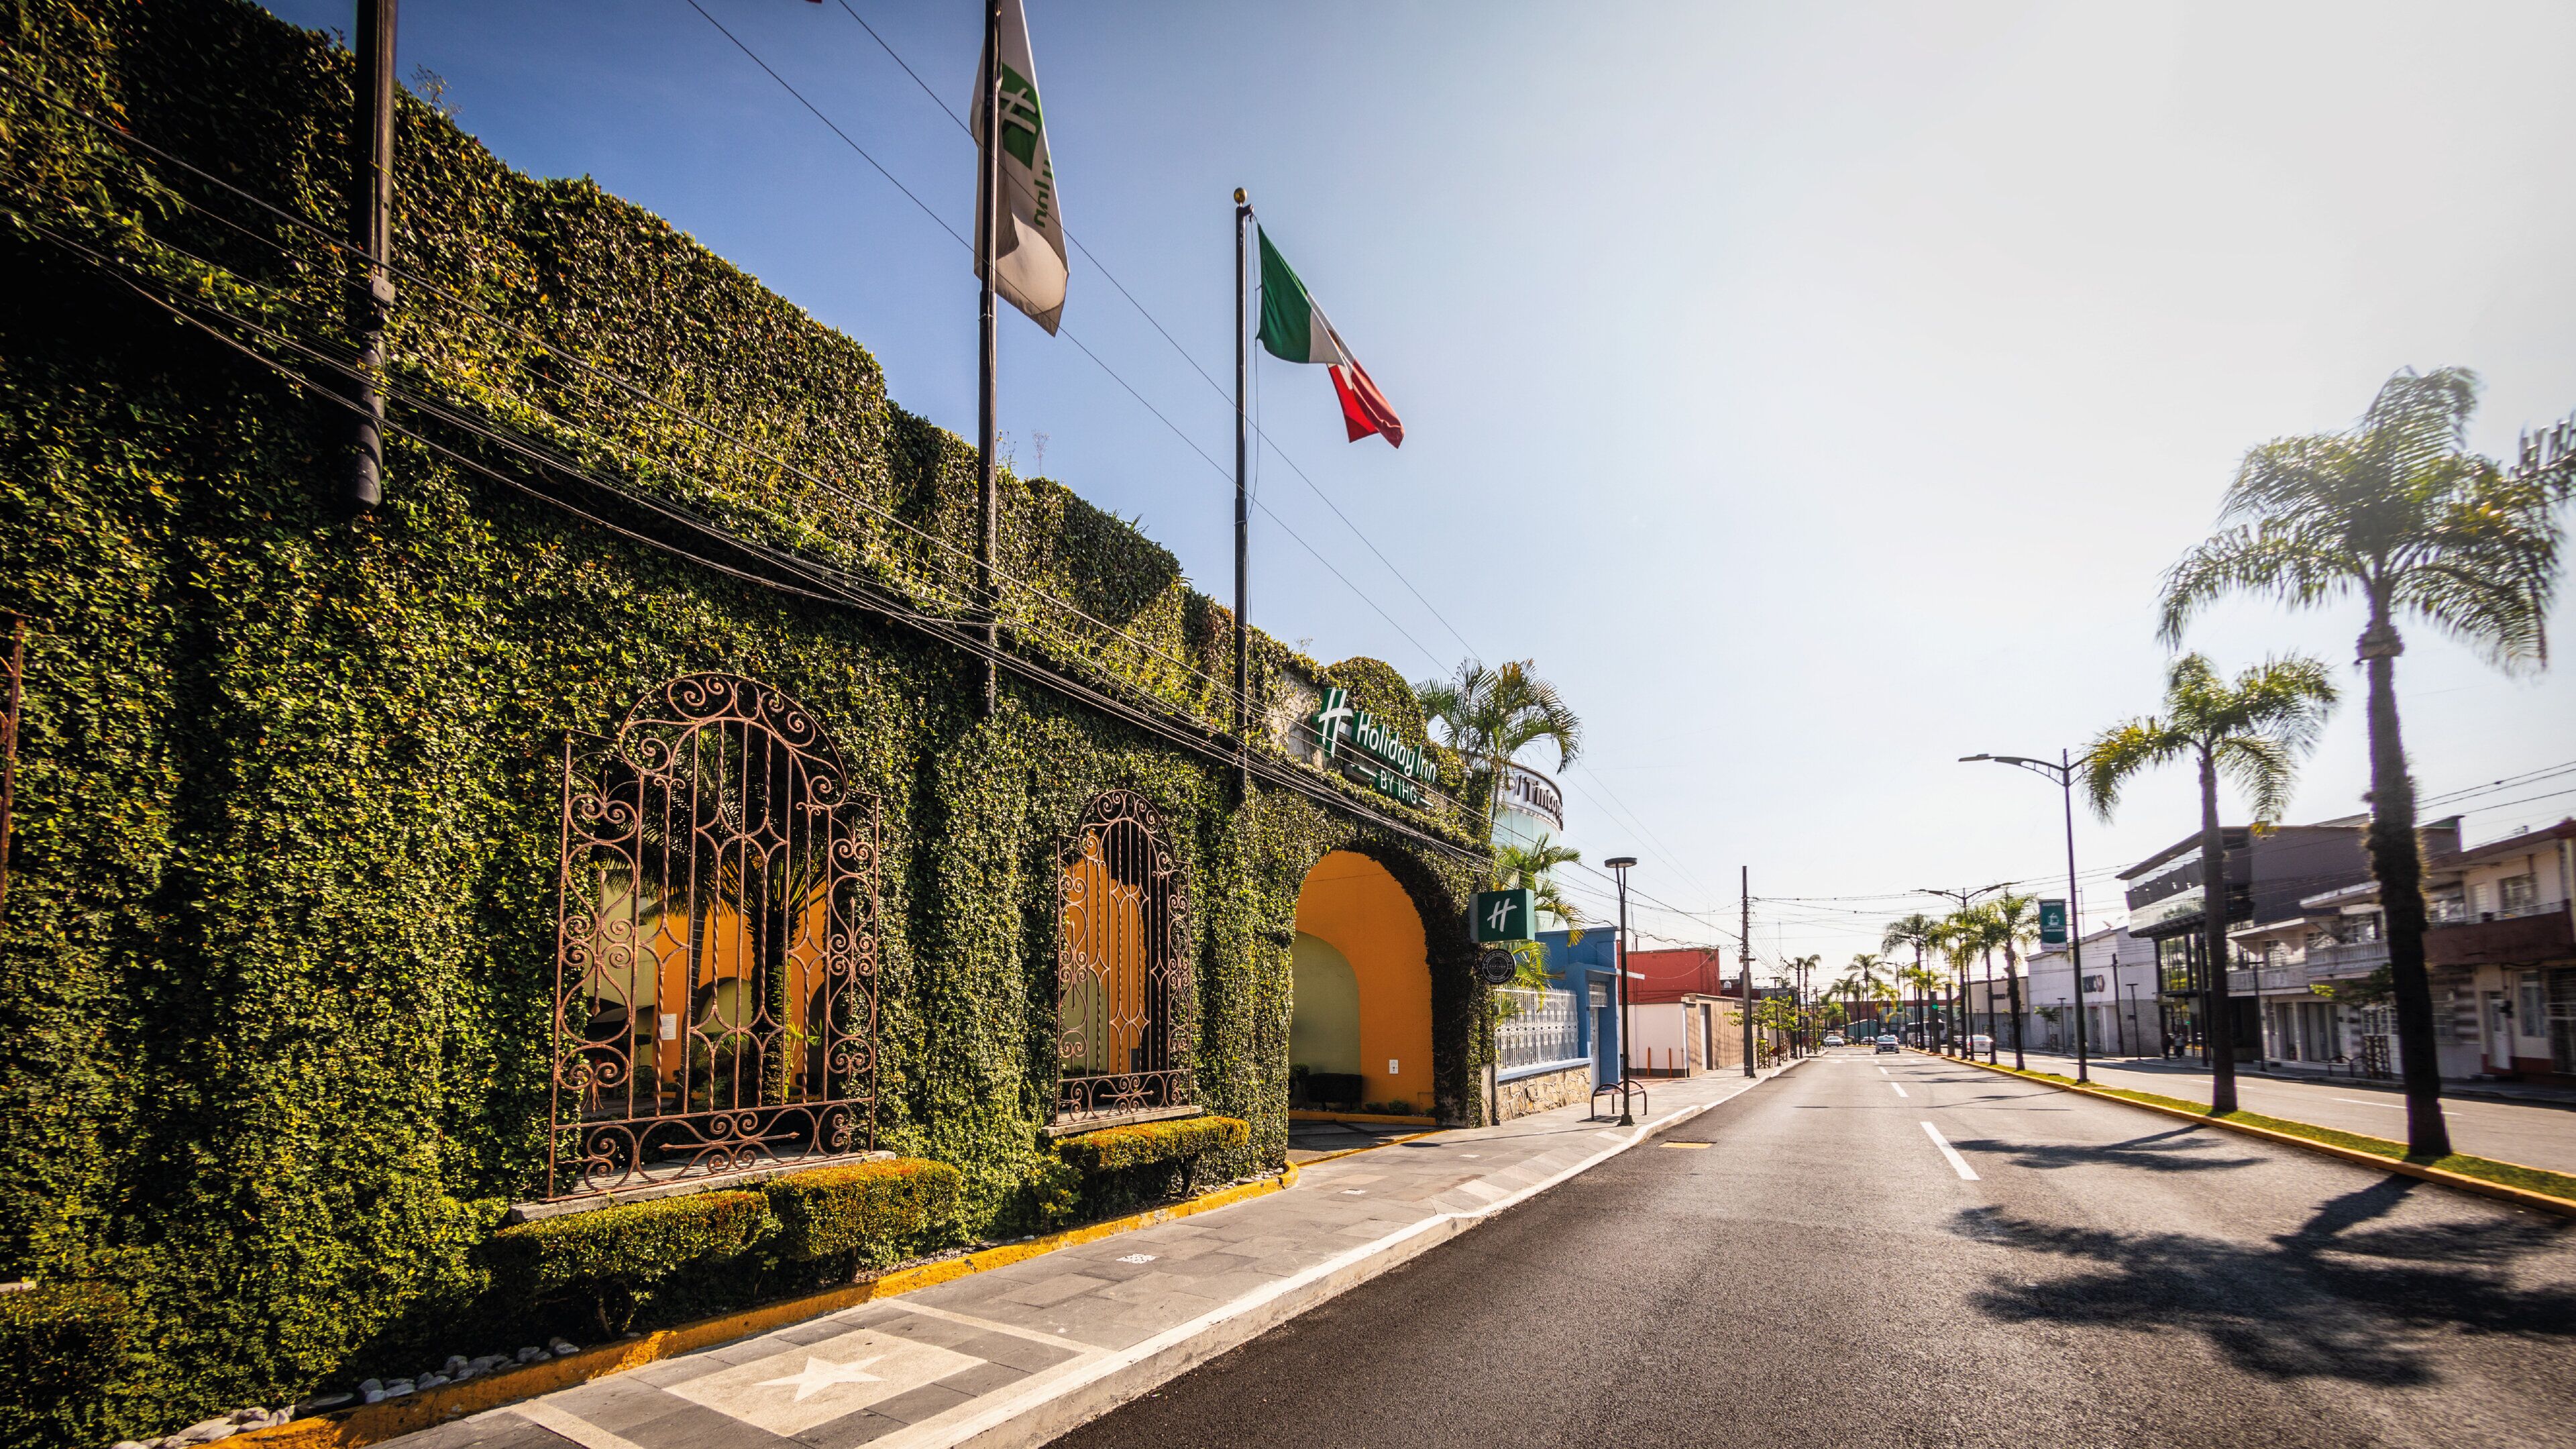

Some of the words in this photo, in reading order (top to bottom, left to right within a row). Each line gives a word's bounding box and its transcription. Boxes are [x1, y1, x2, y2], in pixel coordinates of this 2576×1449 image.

[1356, 710, 1415, 777] Holiday
[1415, 745, 1437, 783] Inn
[1381, 769, 1395, 793] BY
[1397, 777, 1417, 804] IHG
